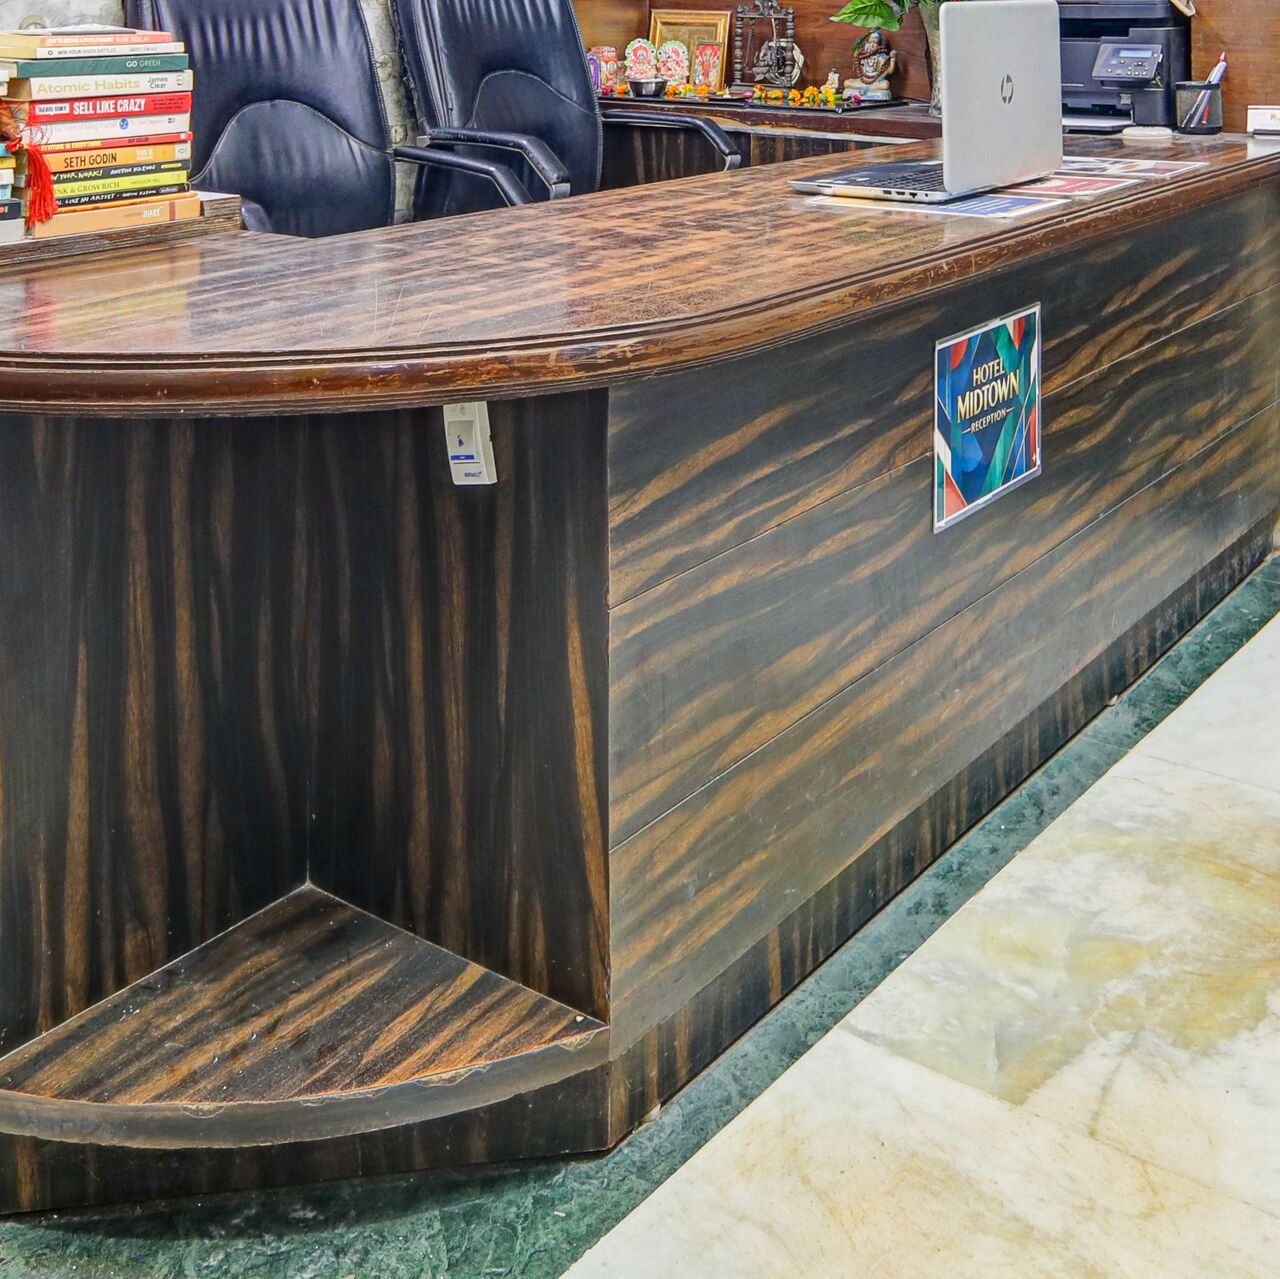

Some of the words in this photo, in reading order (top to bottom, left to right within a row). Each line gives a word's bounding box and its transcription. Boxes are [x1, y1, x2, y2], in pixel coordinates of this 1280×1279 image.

[139, 59, 160, 67] GREEN
[37, 82, 90, 94] Atomic
[95, 79, 140, 90] Habits
[73, 102, 94, 114] SELL
[96, 100, 115, 113] LIKE
[117, 99, 145, 112] CRAZY
[64, 157, 86, 168] SETH
[89, 152, 117, 166] GODIN
[110, 167, 132, 175] AUSTIN
[77, 184, 100, 193] GROW
[102, 182, 120, 190] RICH
[973, 357, 1005, 387] HOTEL
[957, 369, 1019, 423] MIDTOWN
[971, 408, 1006, 433] RECEPTION
